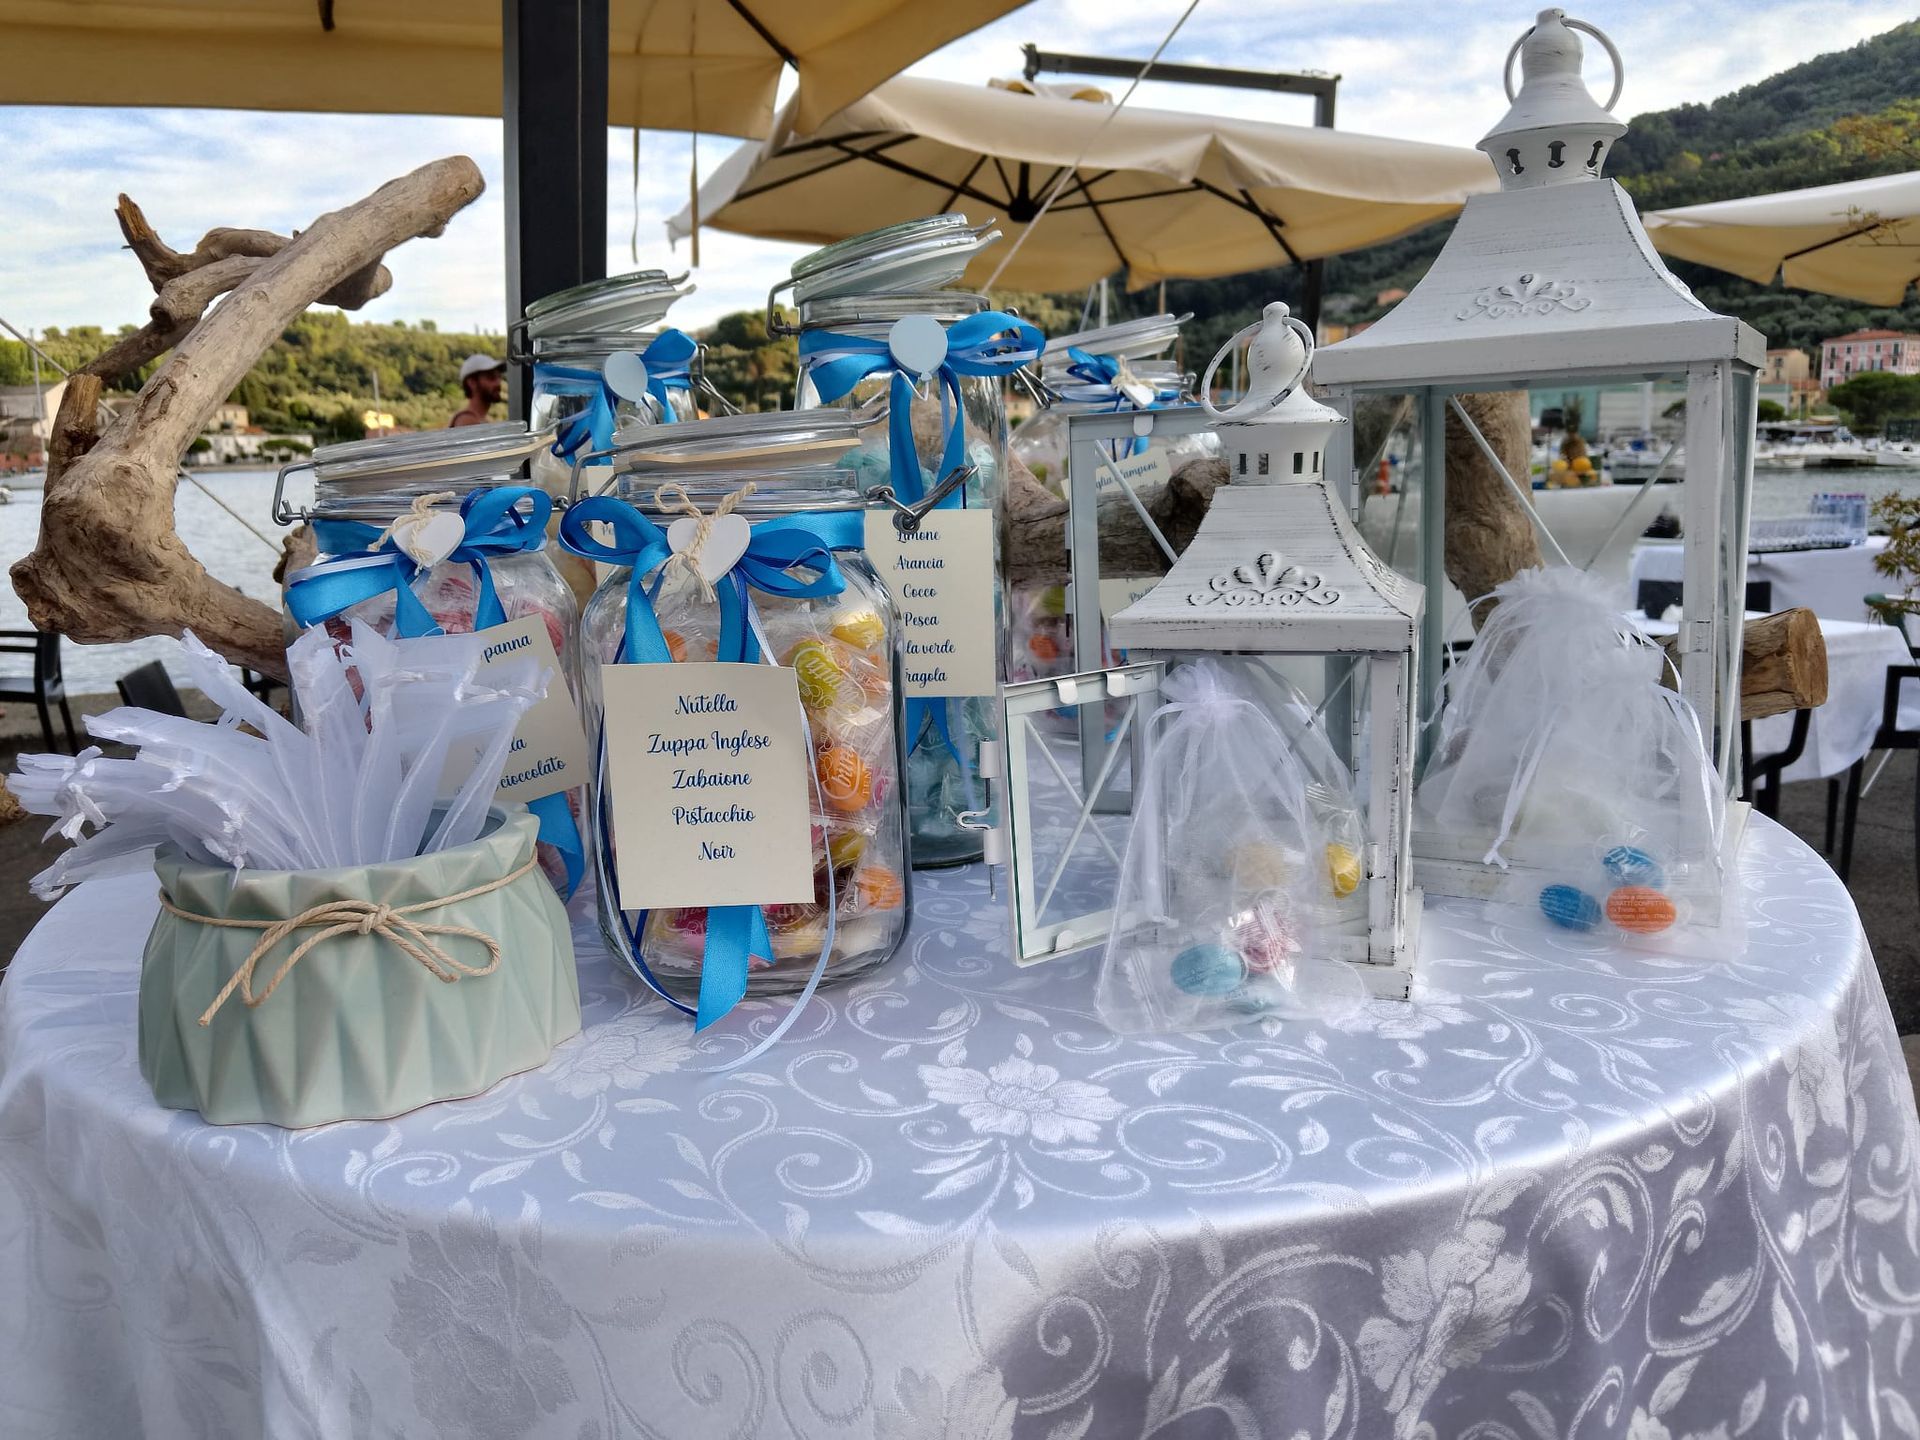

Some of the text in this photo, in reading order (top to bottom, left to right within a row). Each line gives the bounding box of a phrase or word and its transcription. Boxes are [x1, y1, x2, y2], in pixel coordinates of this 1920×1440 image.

[1120, 461, 1158, 481] amponi
[893, 554, 945, 571] Arancia
[903, 583, 937, 598] Cocco
[903, 611, 940, 627] Pesca
[483, 634, 533, 664] panna
[906, 639, 956, 655] la verde
[904, 666, 948, 689] ragola
[674, 693, 738, 715] Nutella
[646, 729, 772, 757] Zuppa Inglese
[501, 755, 567, 789] cioccolato
[671, 768, 752, 790] Zabaione
[671, 803, 756, 826] Pistacchio
[697, 840, 736, 861] Noir
